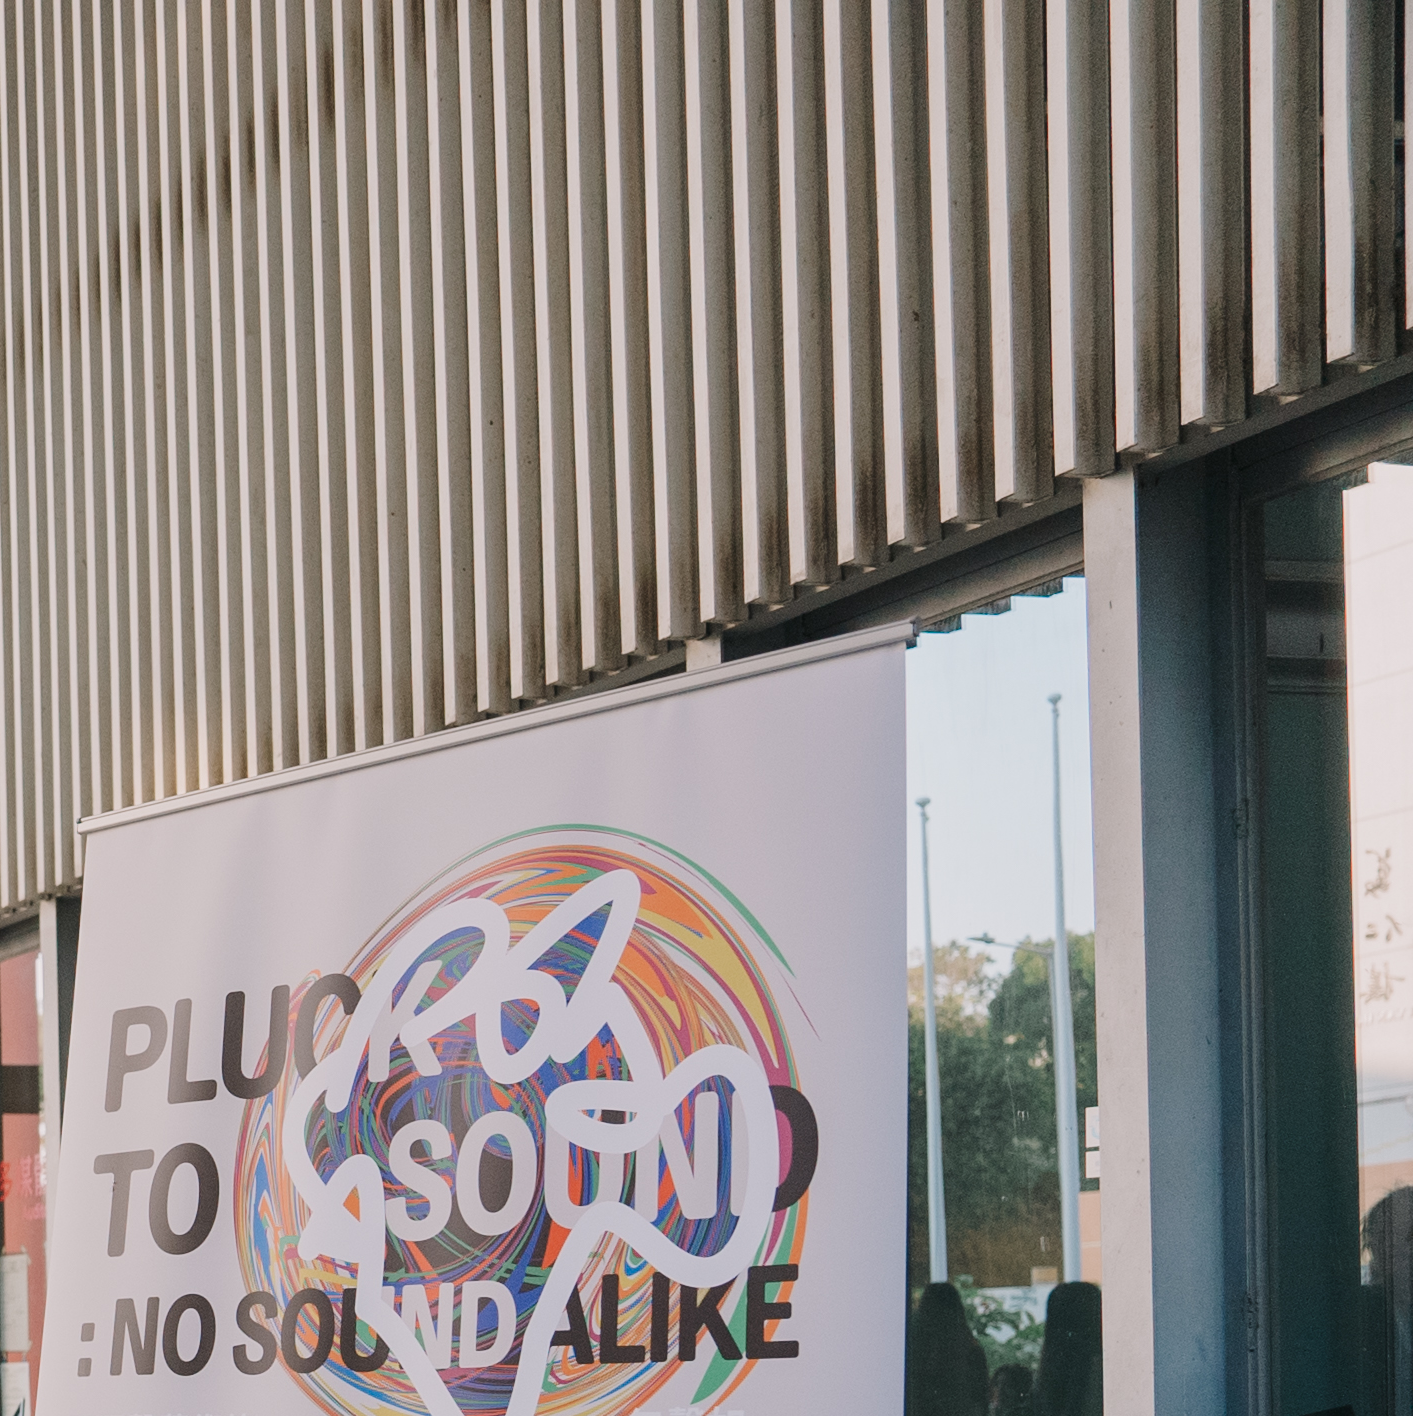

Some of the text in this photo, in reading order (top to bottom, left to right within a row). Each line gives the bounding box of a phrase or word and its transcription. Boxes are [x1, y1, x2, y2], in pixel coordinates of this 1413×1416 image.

[104, 960, 443, 1113] PLUCK
[93, 1142, 219, 1256] TO
[386, 1085, 819, 1242] SOUND
[110, 1295, 216, 1375] NO
[232, 1278, 518, 1373] SOUND
[549, 1265, 800, 1365] ALIKE
